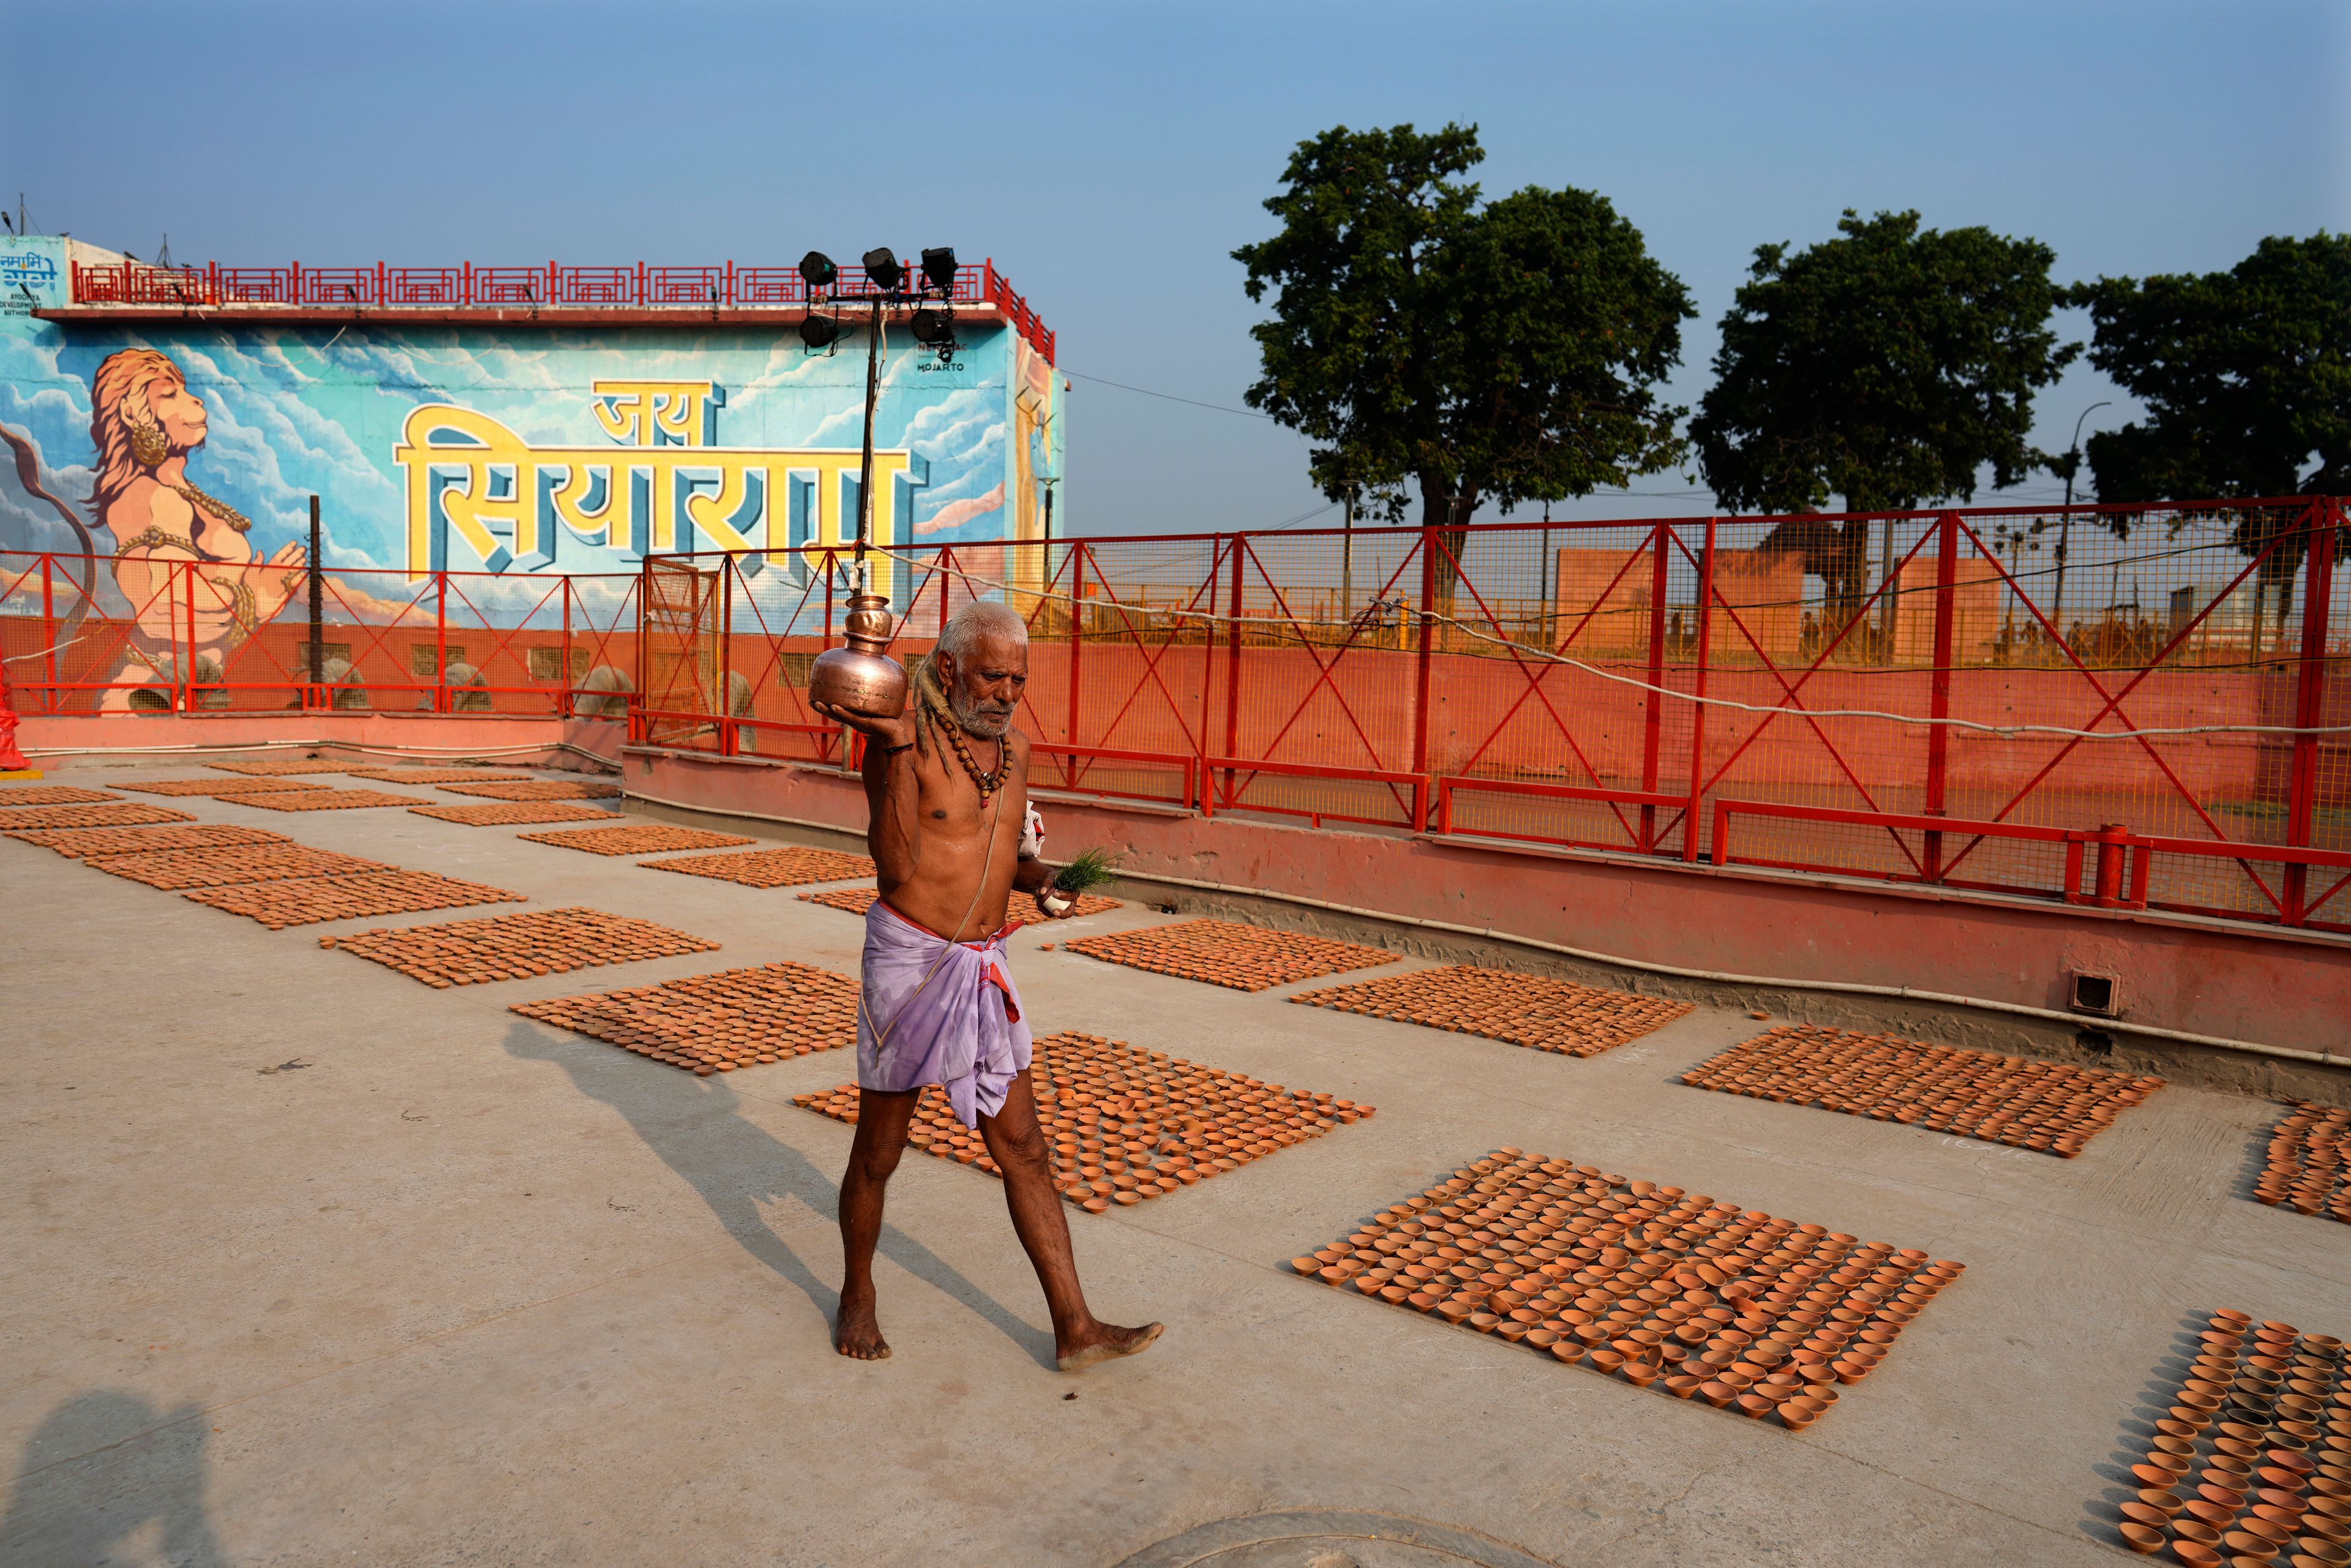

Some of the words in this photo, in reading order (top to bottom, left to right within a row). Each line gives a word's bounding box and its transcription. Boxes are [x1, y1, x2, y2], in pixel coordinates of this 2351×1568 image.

[917, 363, 964, 372] MOJARTO
[590, 378, 714, 446] जय
[392, 402, 912, 611] सियाराम
